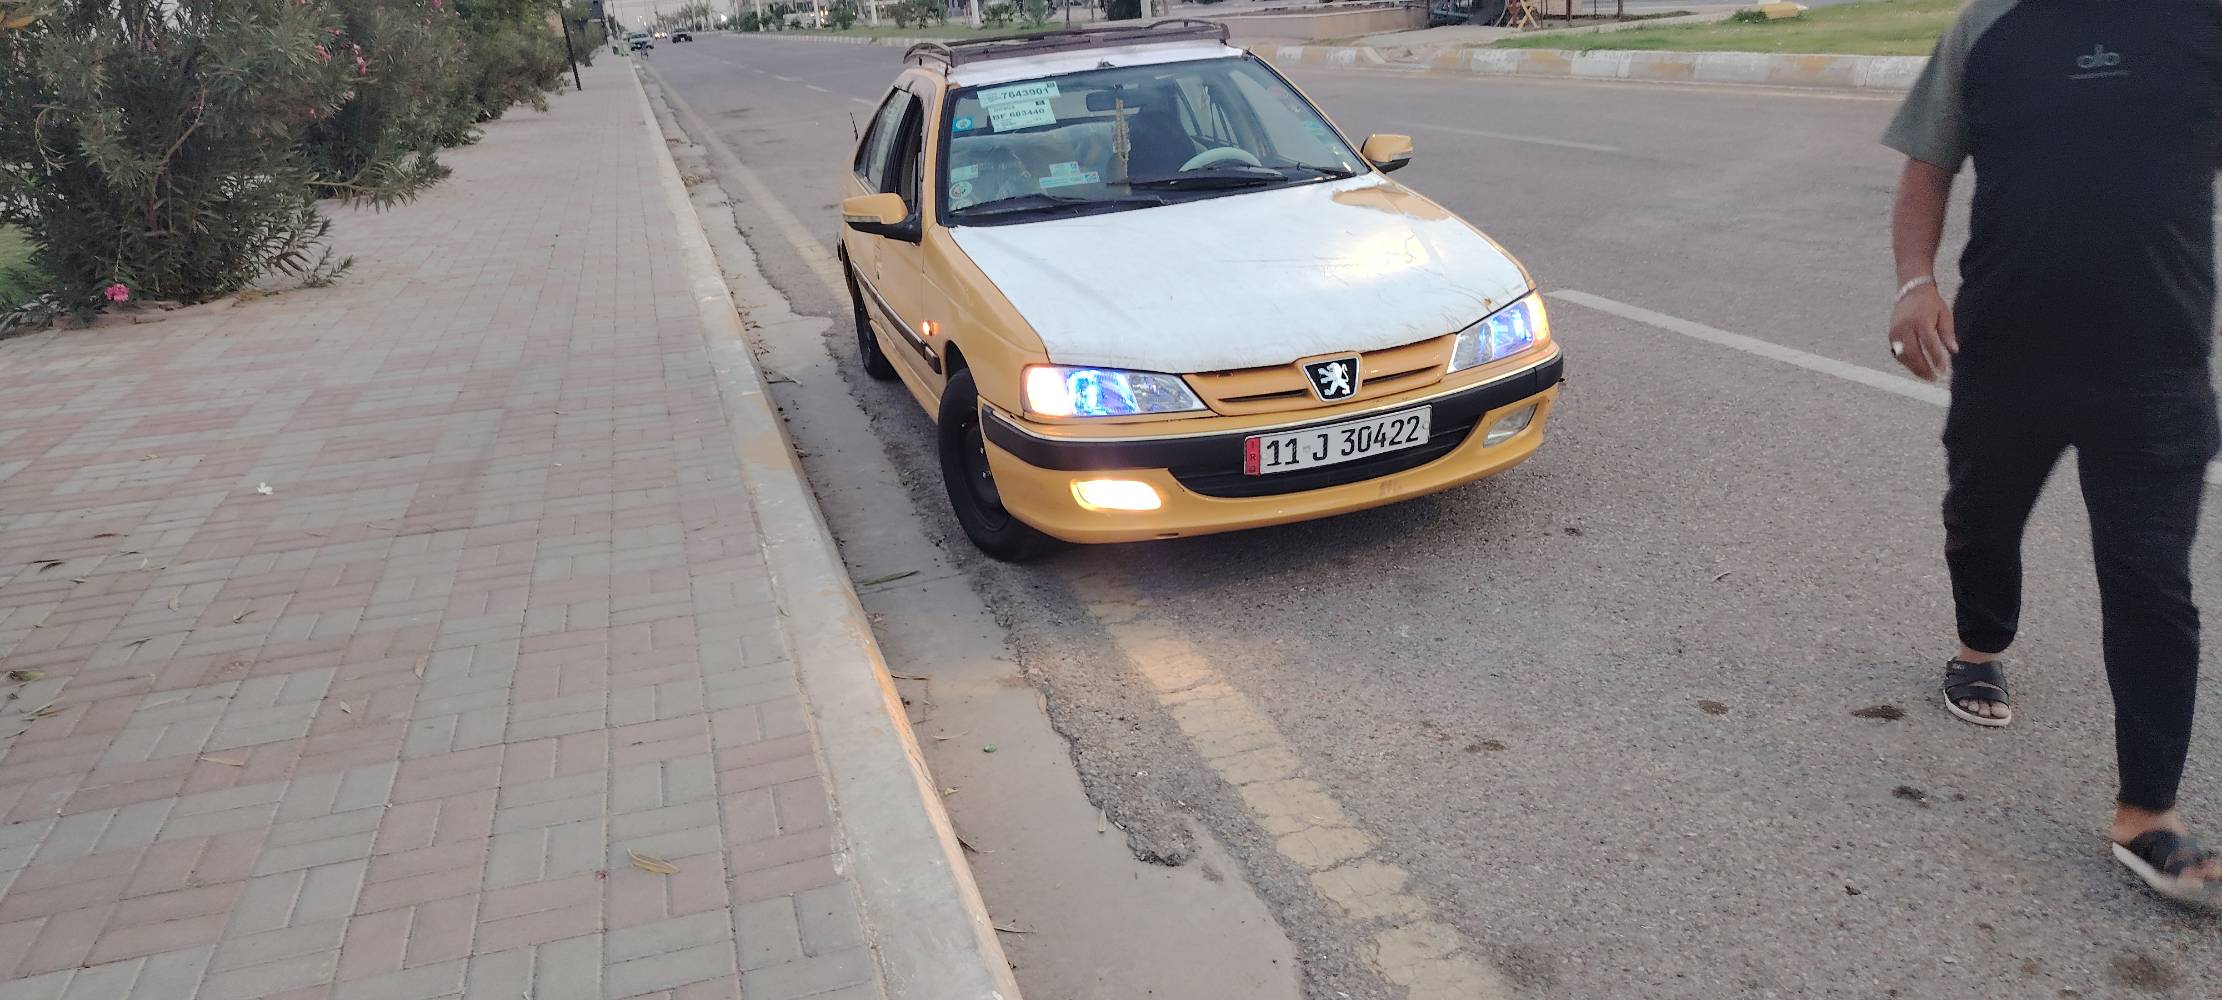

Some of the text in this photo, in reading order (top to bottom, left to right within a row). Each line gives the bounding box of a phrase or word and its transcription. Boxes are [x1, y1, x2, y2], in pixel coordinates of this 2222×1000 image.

[1001, 87, 1049, 99] 7643901
[1266, 416, 1420, 466] 11 J 30422
